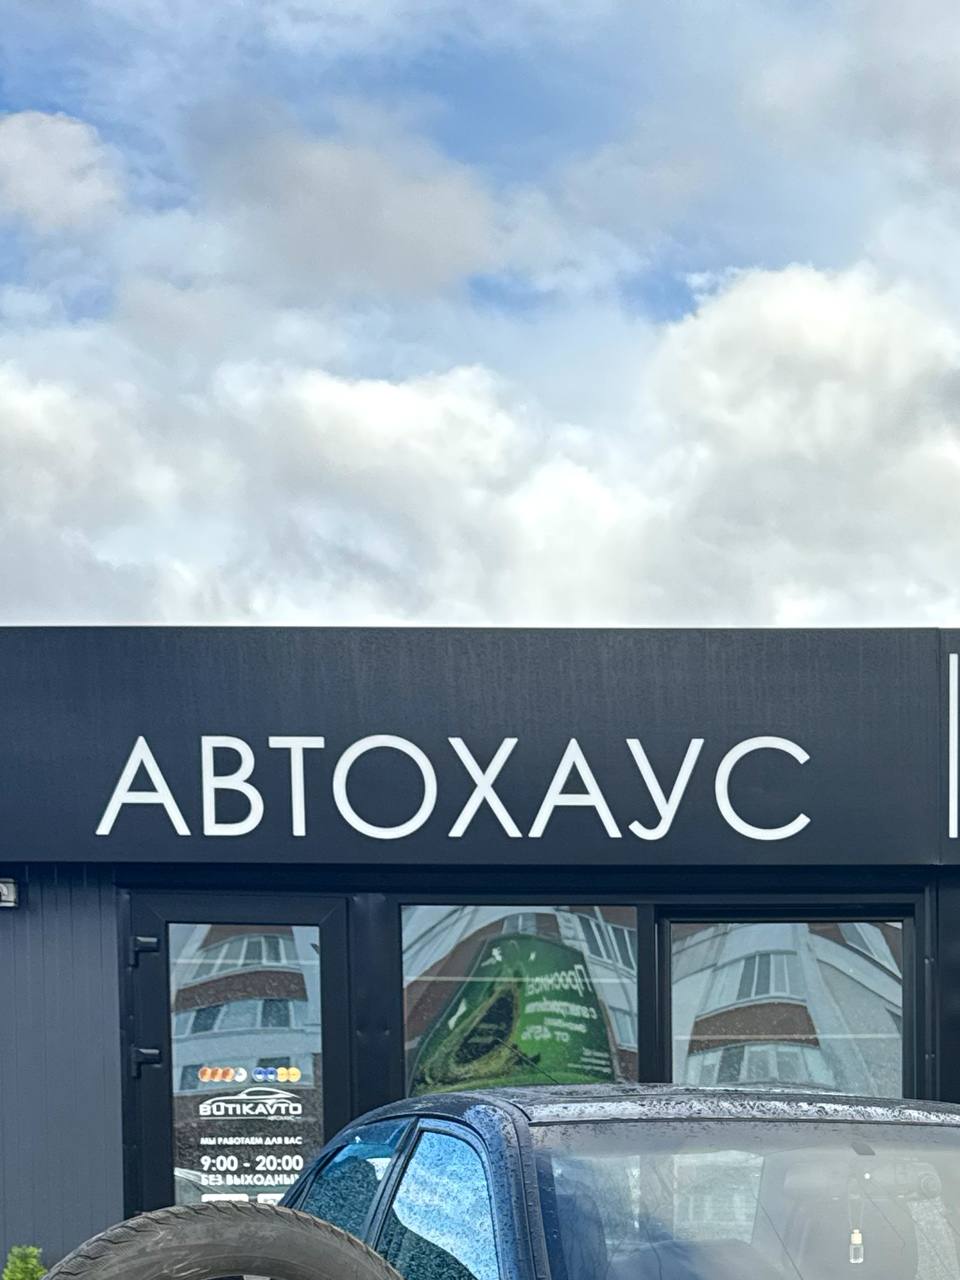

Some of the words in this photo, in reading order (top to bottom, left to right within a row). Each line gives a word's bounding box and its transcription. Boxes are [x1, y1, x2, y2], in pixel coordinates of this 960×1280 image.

[96, 735, 811, 841] АВТОХАУС
[199, 1102, 302, 1115] BUTIKAVTO
[218, 1137, 263, 1145] РАБОТАЕМ
[264, 1137, 283, 1145] ДЛЯ
[284, 1136, 303, 1145] ВАС
[200, 1155, 239, 1171] 9:00
[255, 1154, 304, 1171] 20:00
[200, 1174, 224, 1186] БЕЗ
